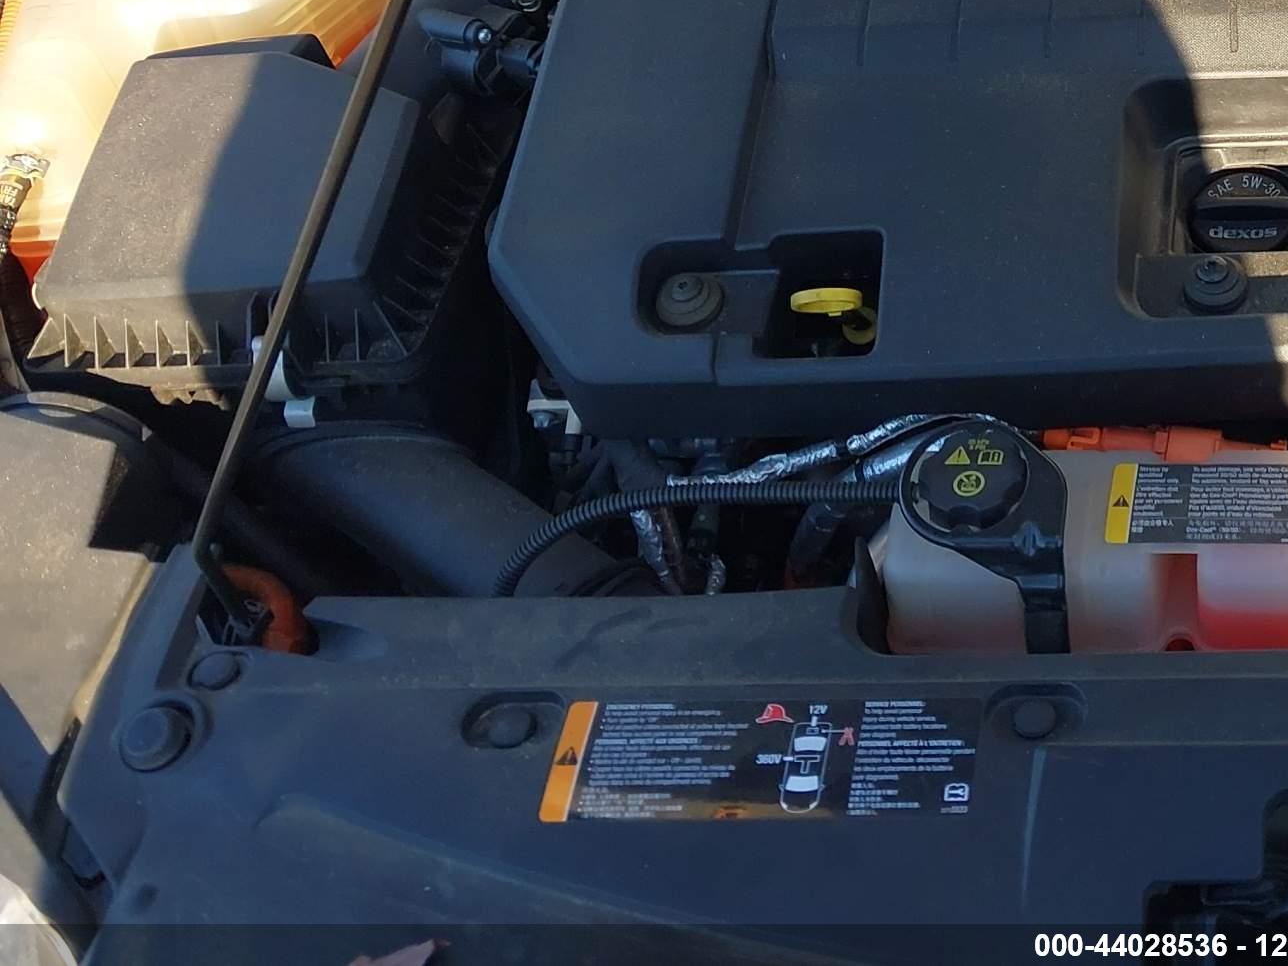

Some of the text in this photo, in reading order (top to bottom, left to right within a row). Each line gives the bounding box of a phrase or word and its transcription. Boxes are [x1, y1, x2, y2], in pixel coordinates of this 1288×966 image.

[1207, 175, 1281, 199] SAE 5W-30
[1209, 226, 1277, 239] dexos
[809, 705, 828, 715] 12V
[755, 754, 782, 764] 360V
